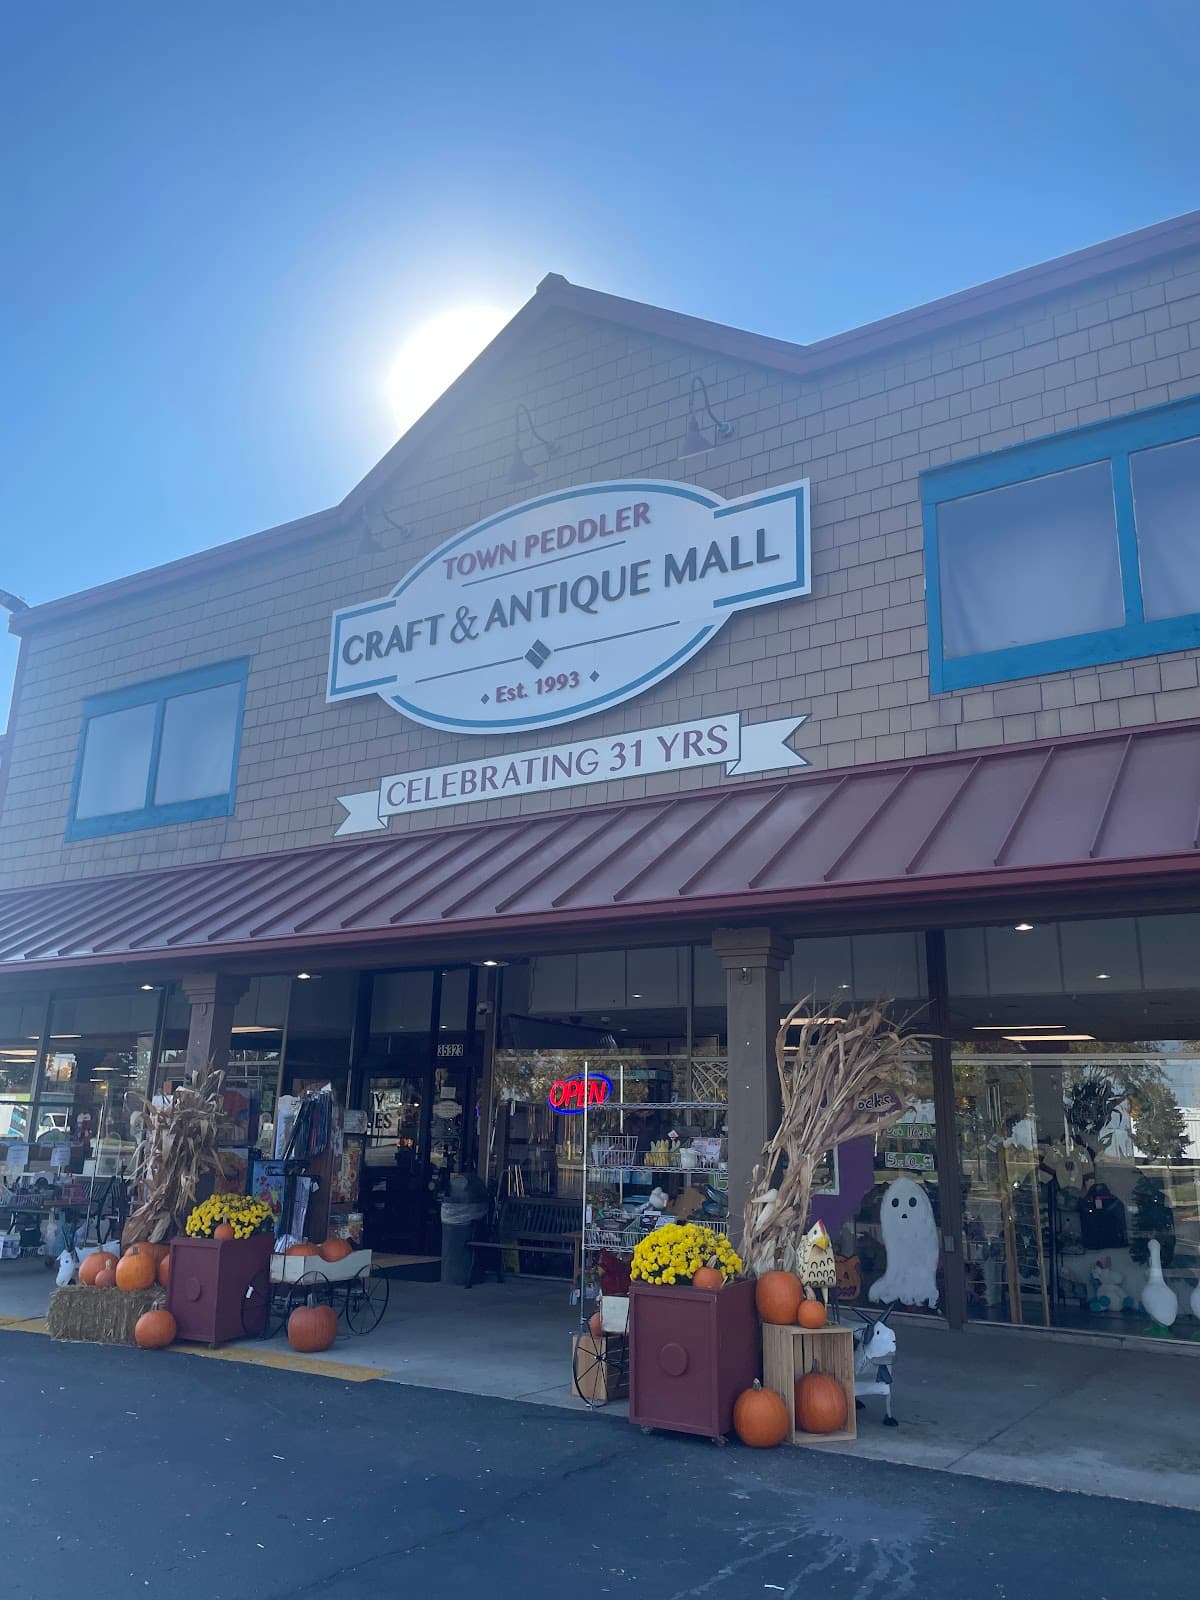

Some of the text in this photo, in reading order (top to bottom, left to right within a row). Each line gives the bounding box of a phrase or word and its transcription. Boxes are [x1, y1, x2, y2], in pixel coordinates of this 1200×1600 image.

[443, 502, 651, 580] TOWN PEDDLER
[342, 528, 780, 665] CRAFT & ANTIQUE MALL
[495, 671, 580, 703] Est. 1993
[387, 724, 728, 806] CELEBRATING 31 YRS
[438, 1045, 462, 1056] 35323
[549, 1079, 607, 1107] OPEN
